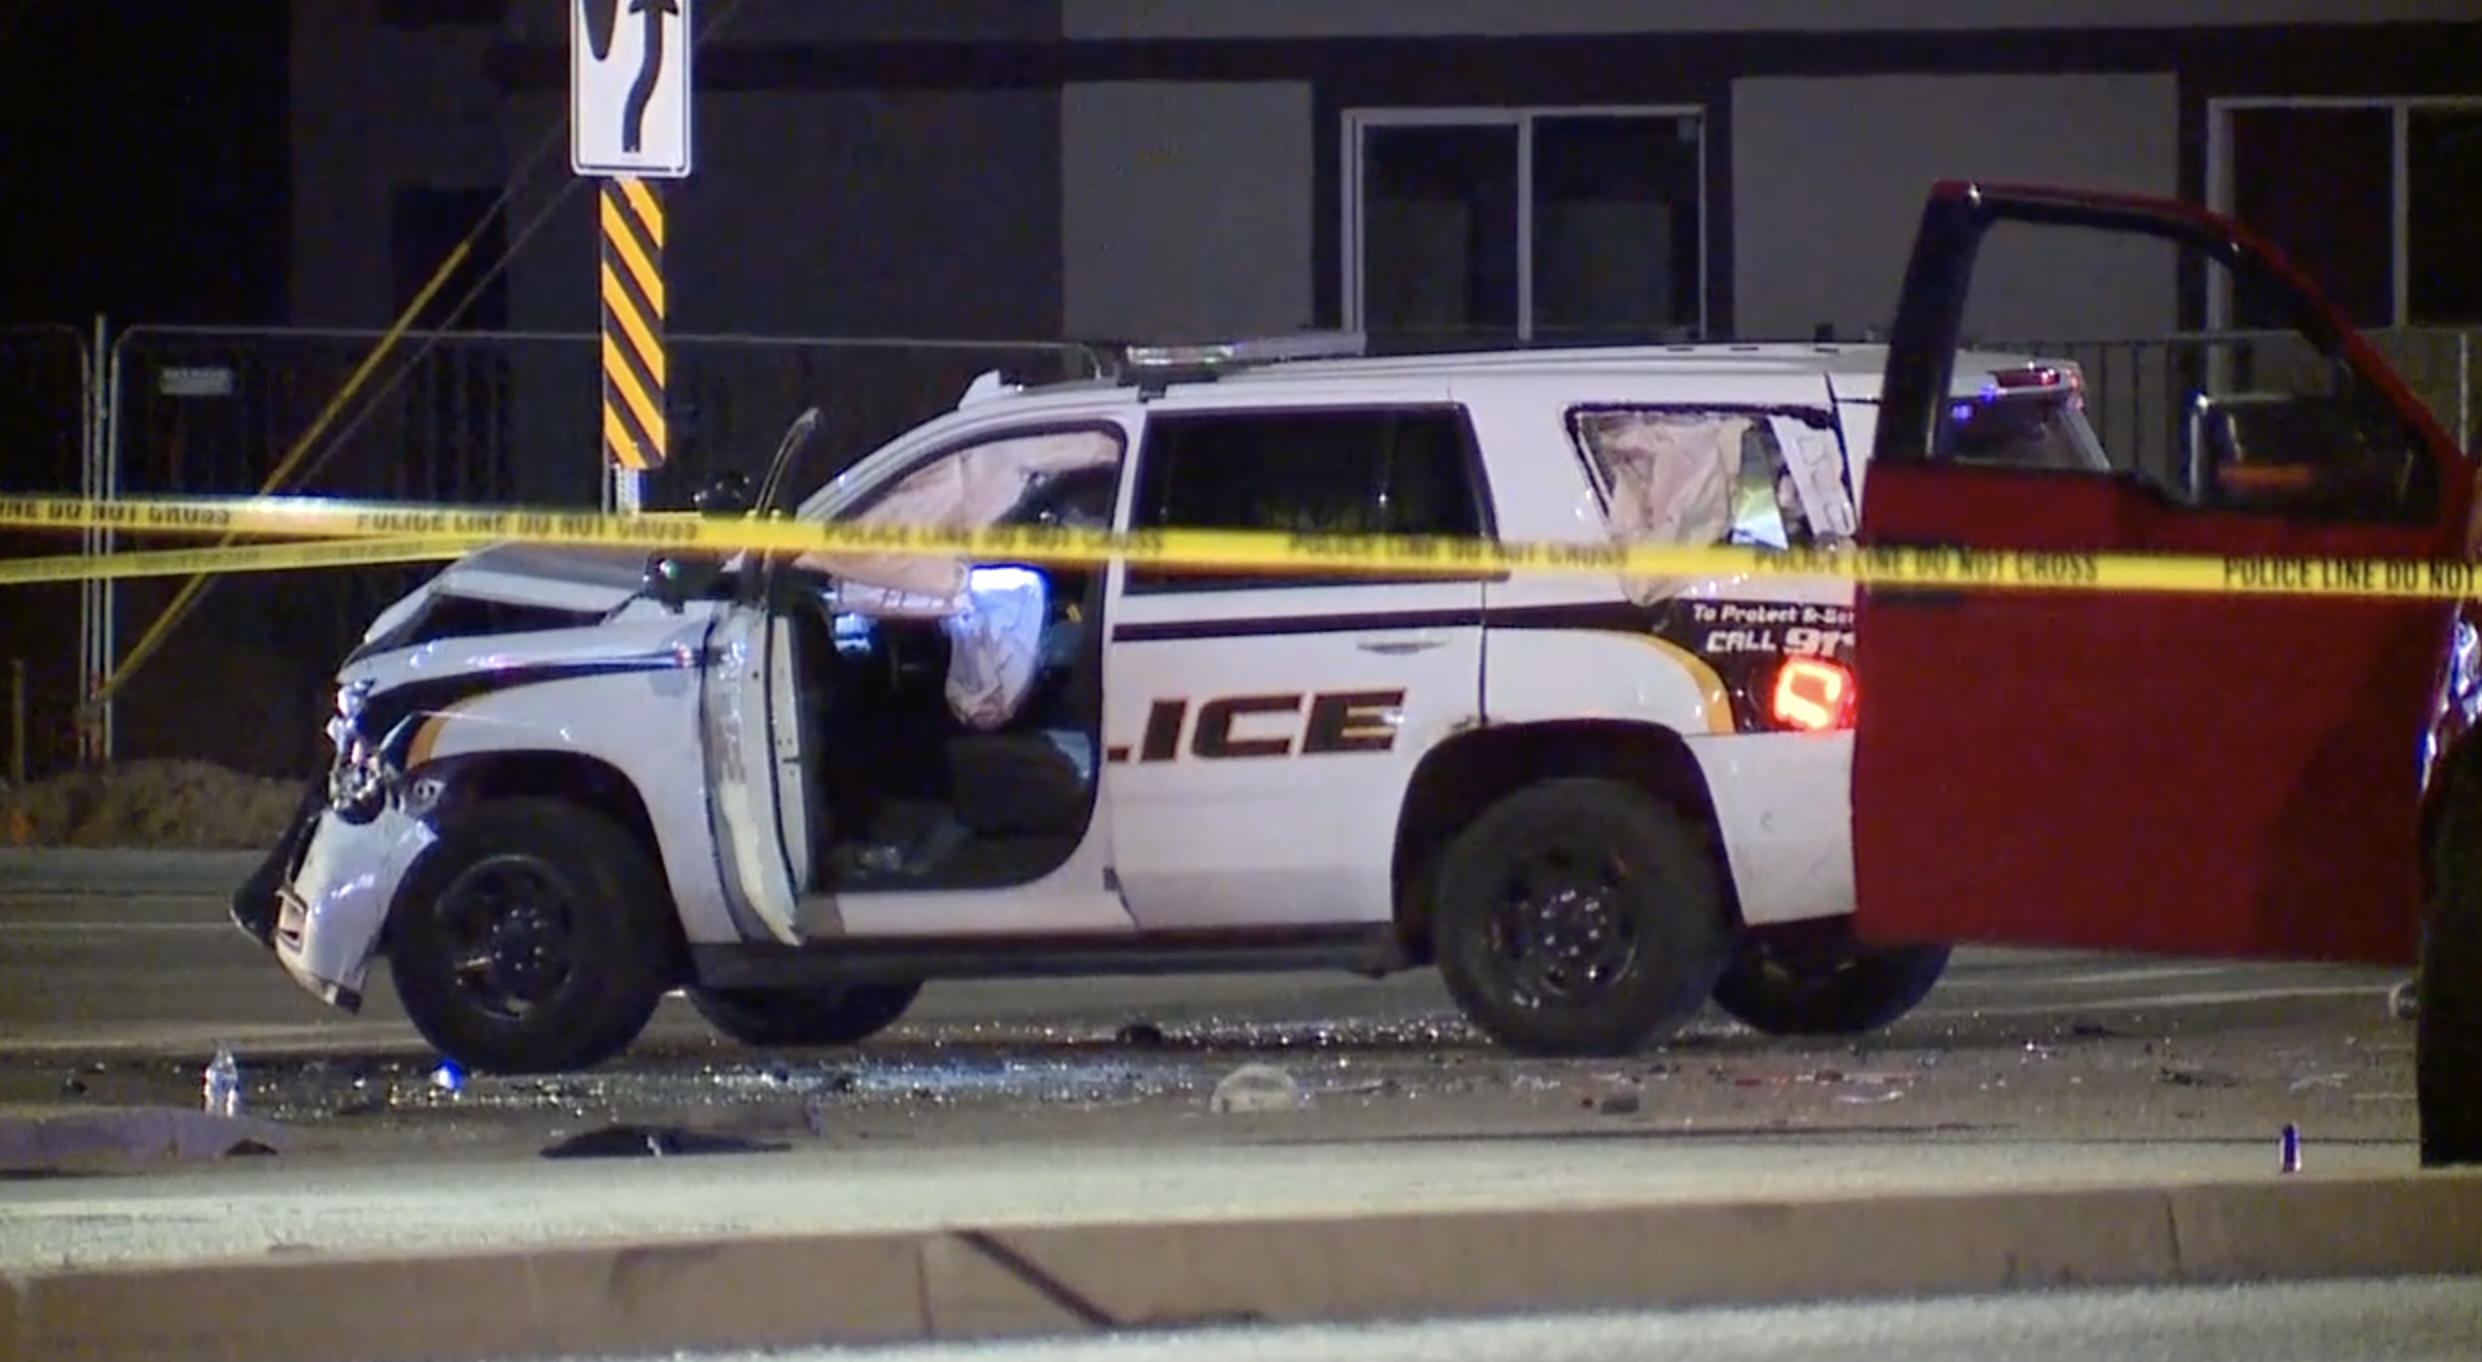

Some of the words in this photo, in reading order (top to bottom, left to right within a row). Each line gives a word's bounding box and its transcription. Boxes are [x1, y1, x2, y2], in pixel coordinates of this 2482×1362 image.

[48, 499, 82, 520] DO
[92, 500, 137, 521] NOT
[149, 502, 231, 525] CROSS
[357, 510, 444, 533] POLICE
[453, 510, 505, 533] LINE
[518, 512, 551, 536] DO
[561, 513, 606, 537] NOT
[617, 515, 698, 541] CROSS
[824, 523, 907, 545] POLICE
[917, 525, 970, 547] LINE
[984, 526, 1015, 549] DO
[1026, 527, 1070, 550] NOT
[1081, 528, 1163, 554] CROSS
[1289, 534, 1376, 559] POLICE
[1386, 536, 1439, 561] LINE
[1452, 537, 1481, 562] DO
[1492, 538, 1537, 564] NOT
[1548, 540, 1629, 567] CROSS
[1754, 547, 1842, 574] POLICE
[1852, 547, 1903, 577] LINE
[1915, 548, 1949, 578] DO
[1959, 550, 2003, 580] NOT
[2015, 553, 2097, 582] CROSS
[2224, 557, 2309, 588] POLICE
[2322, 557, 2375, 590] LINE
[2385, 558, 2418, 591] DO
[2430, 560, 2474, 592] NOT
[1693, 604, 1717, 621] To
[1721, 604, 1798, 622] Protect
[1706, 630, 1777, 653] CALL
[1107, 688, 1406, 763] ICE
